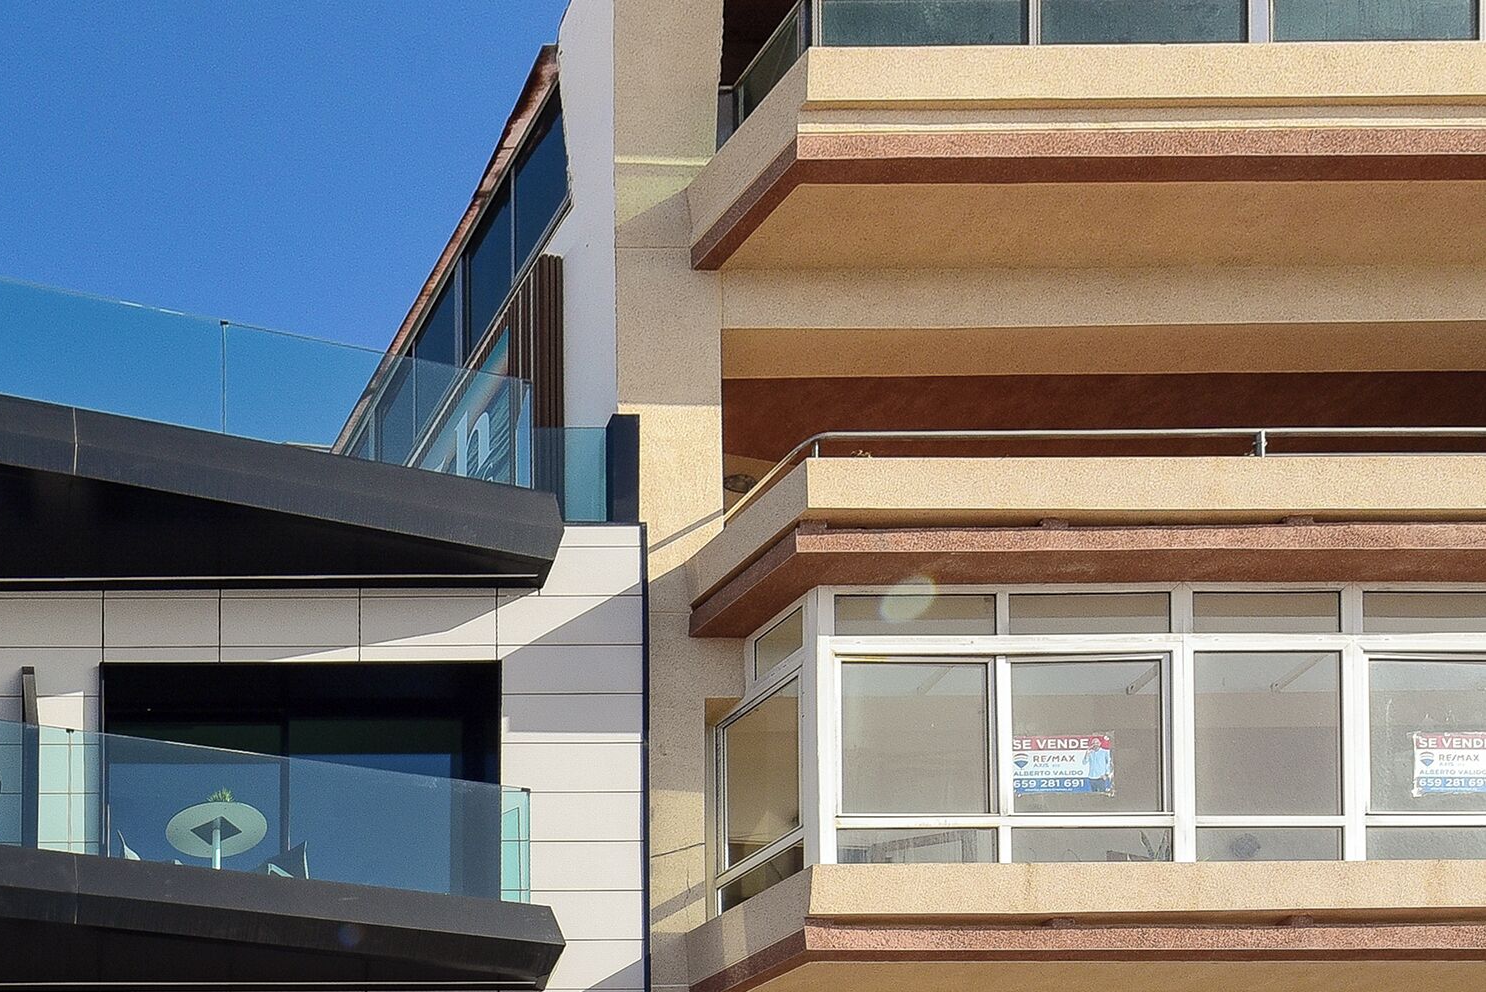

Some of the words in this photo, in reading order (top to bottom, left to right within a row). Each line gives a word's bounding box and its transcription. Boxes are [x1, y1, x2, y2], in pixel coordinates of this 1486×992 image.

[1014, 739, 1032, 750] SE
[1036, 738, 1089, 749] VENDE
[1418, 737, 1437, 748] SE
[1441, 737, 1486, 748] VEND
[1033, 755, 1076, 763] RE/MAX
[1438, 754, 1480, 762] RE/MAX
[1014, 780, 1037, 788] 659
[1040, 780, 1061, 788] 281
[1063, 779, 1084, 788] 691
[1419, 778, 1442, 787] 659
[1445, 778, 1465, 787] 281
